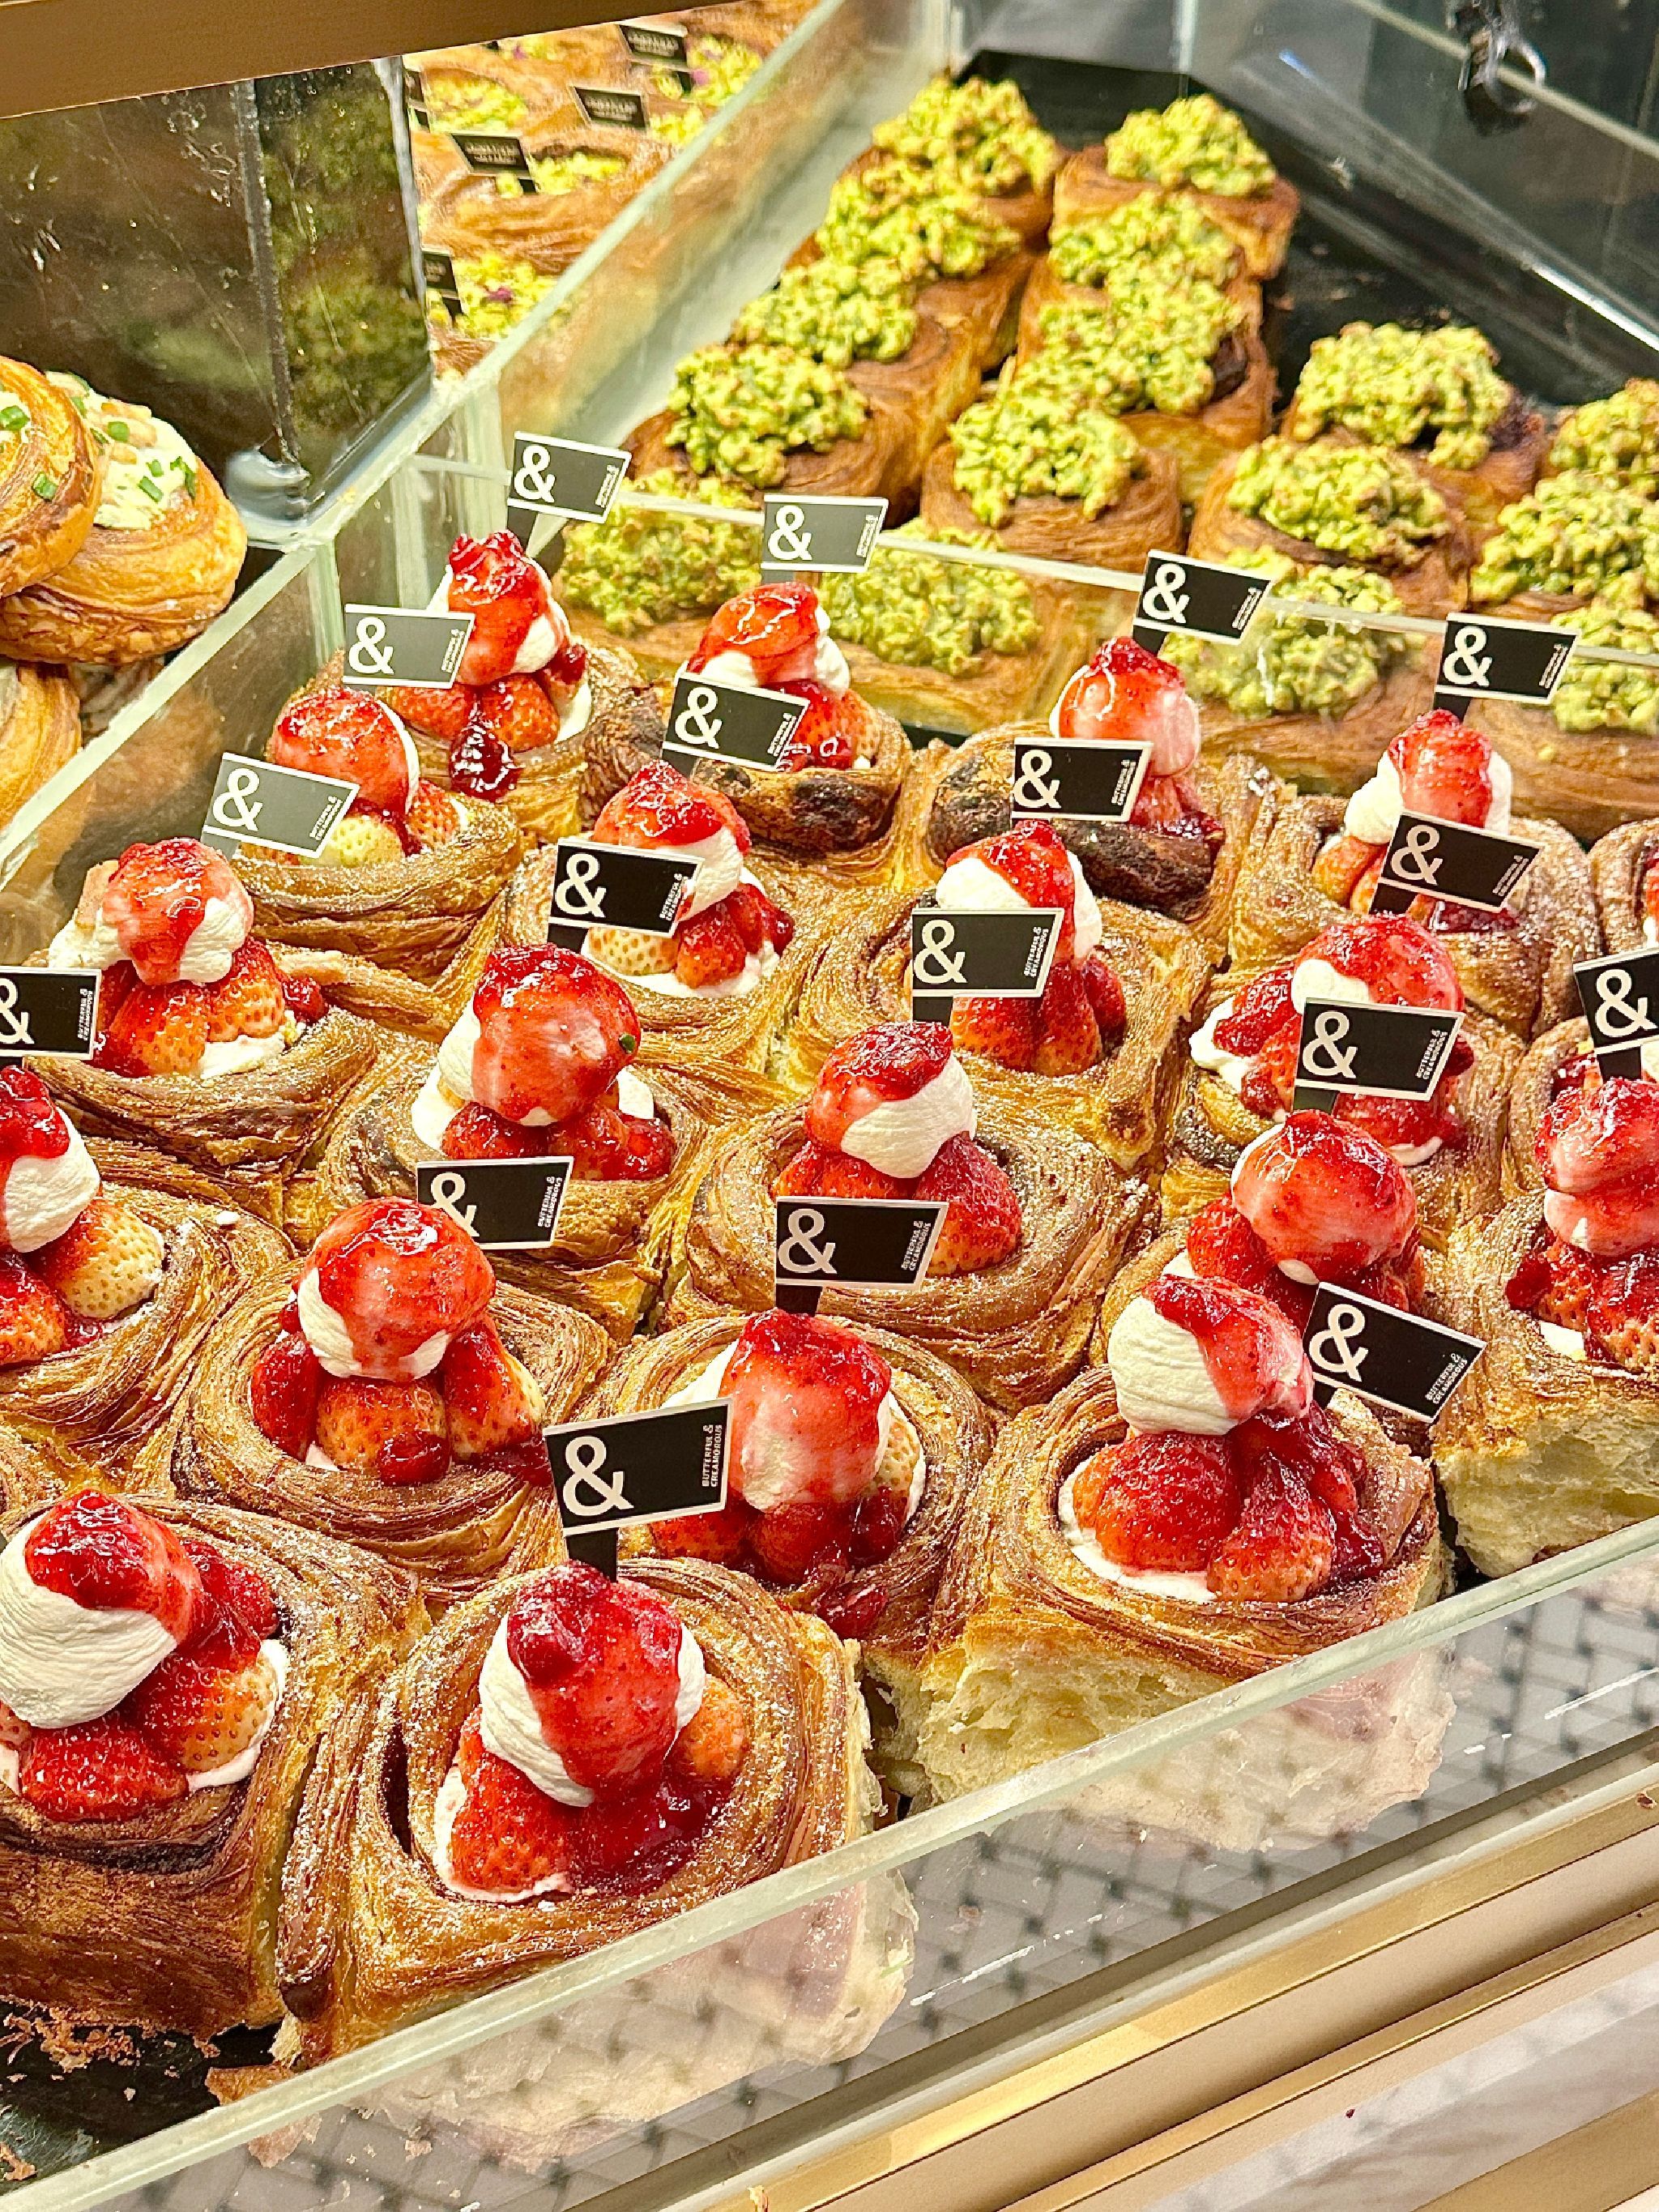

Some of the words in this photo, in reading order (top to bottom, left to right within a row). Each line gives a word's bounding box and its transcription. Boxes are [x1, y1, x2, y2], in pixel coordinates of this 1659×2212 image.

[514, 444, 555, 502] &
[768, 506, 812, 560] &
[1143, 563, 1189, 623] &
[349, 617, 394, 673] &
[1443, 626, 1492, 685] &
[675, 687, 722, 749] &
[213, 768, 262, 831] &
[1013, 749, 1062, 809] &
[555, 854, 606, 917] &
[1391, 825, 1443, 886] &
[914, 920, 966, 983] &
[1595, 969, 1657, 1037] &
[1303, 1010, 1358, 1078] &
[778, 1209, 837, 1274] &
[1309, 1304, 1368, 1381] &
[563, 1437, 633, 1516] &
[702, 1436, 713, 1487] BUTTERFUL
[711, 1424, 722, 1488] CREAMOROUS
